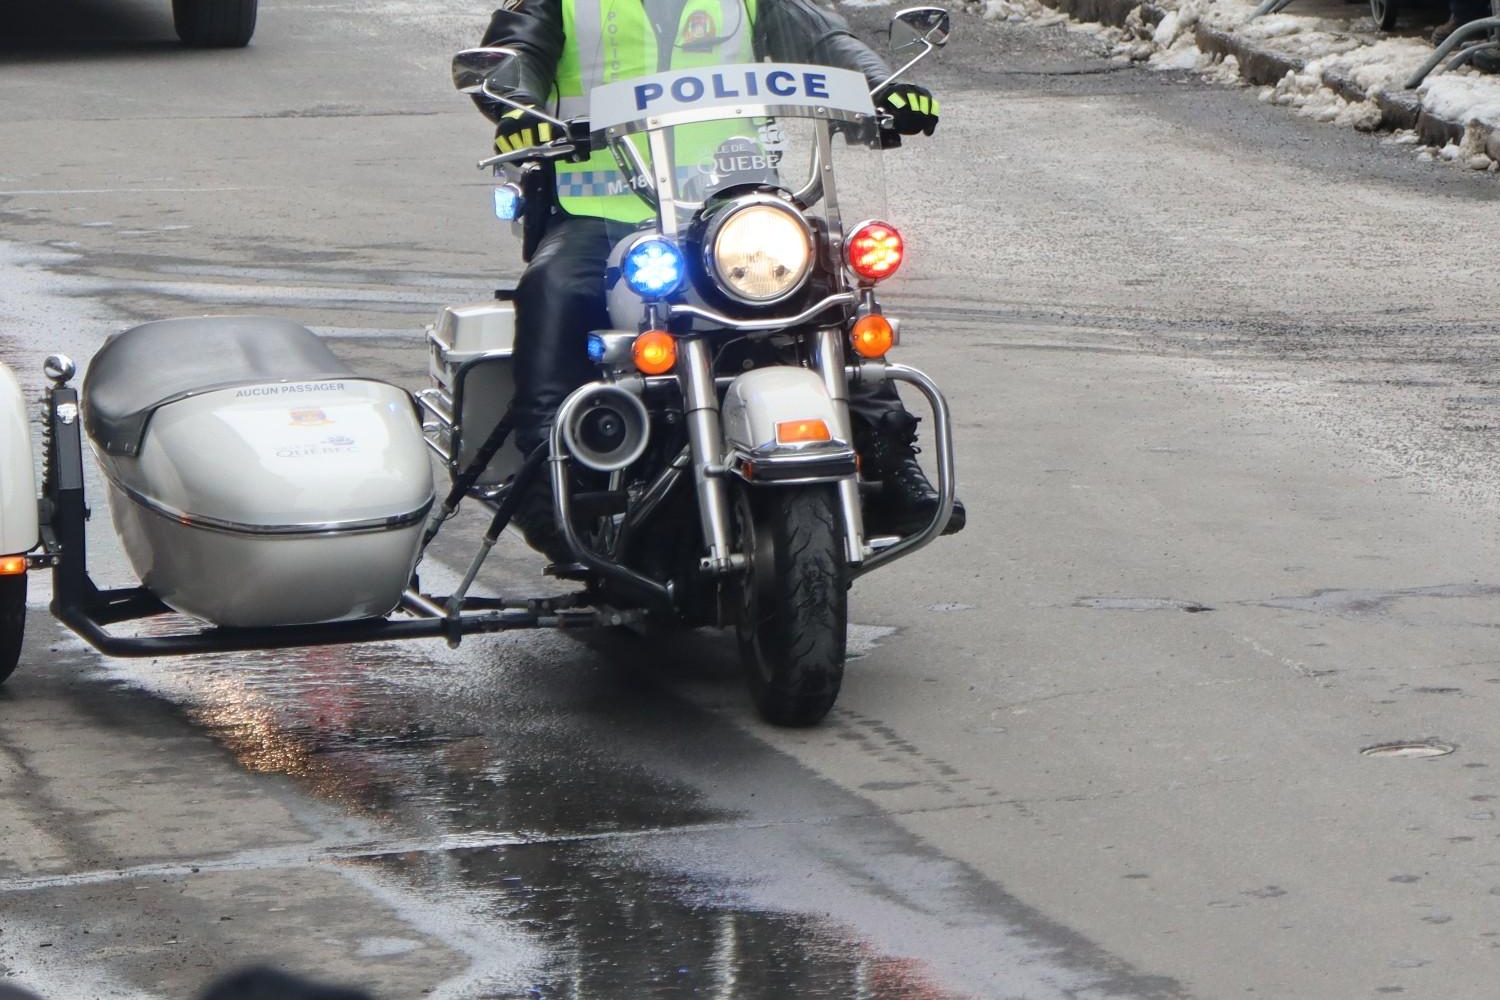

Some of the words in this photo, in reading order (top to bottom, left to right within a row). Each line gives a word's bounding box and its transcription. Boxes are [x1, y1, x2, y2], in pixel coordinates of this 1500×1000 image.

[634, 71, 830, 111] POLICE
[731, 143, 747, 153] DE
[607, 174, 648, 195] M-18
[235, 386, 278, 398] AUCUN
[281, 382, 346, 393] PASSAGER
